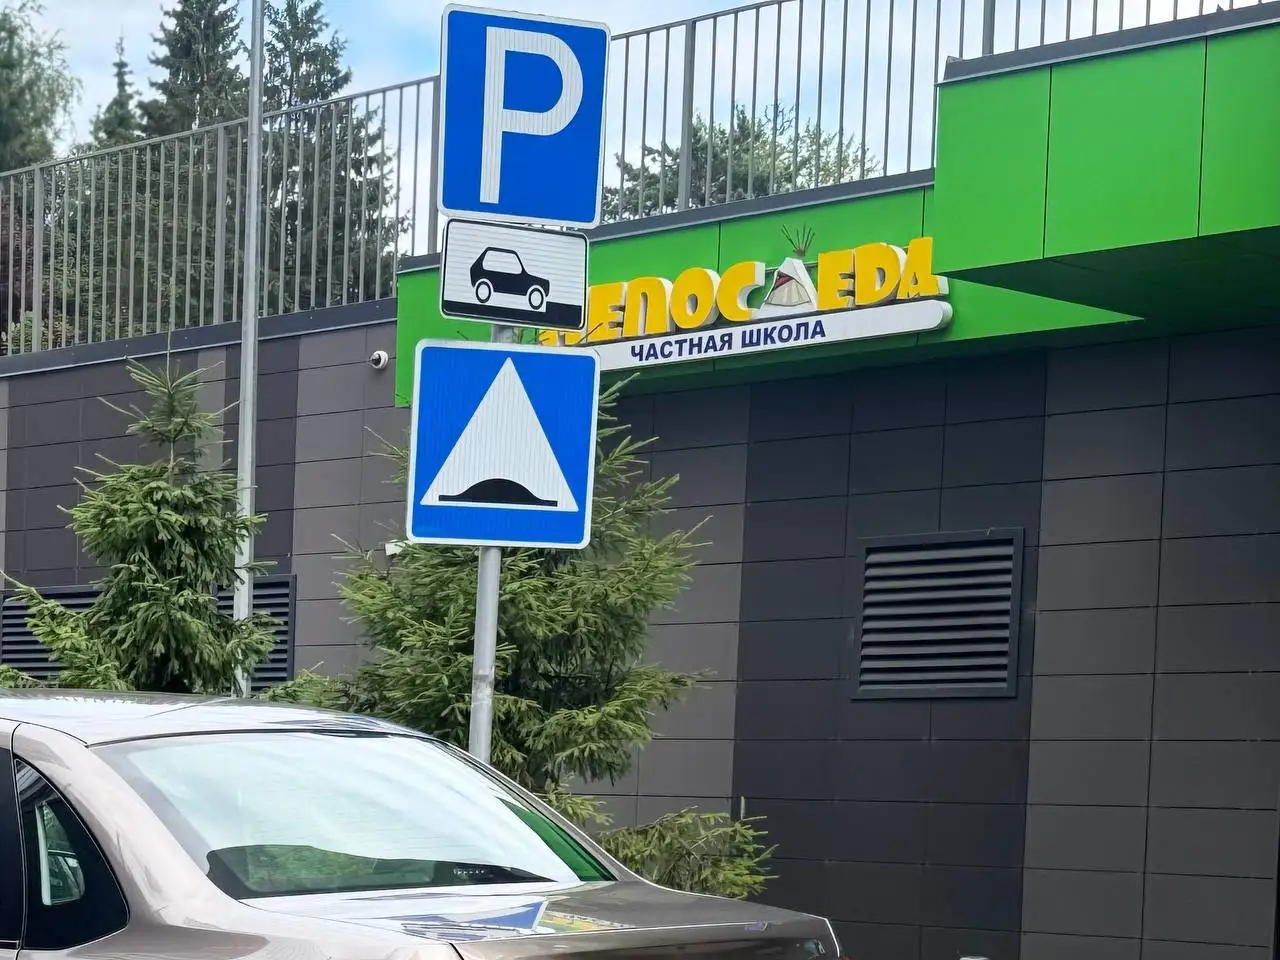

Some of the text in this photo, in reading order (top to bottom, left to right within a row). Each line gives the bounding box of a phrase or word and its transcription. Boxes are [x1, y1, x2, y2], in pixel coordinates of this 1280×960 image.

[479, 26, 584, 205] P
[631, 319, 826, 362] ЧАСТНАЯ ШКОЛА
